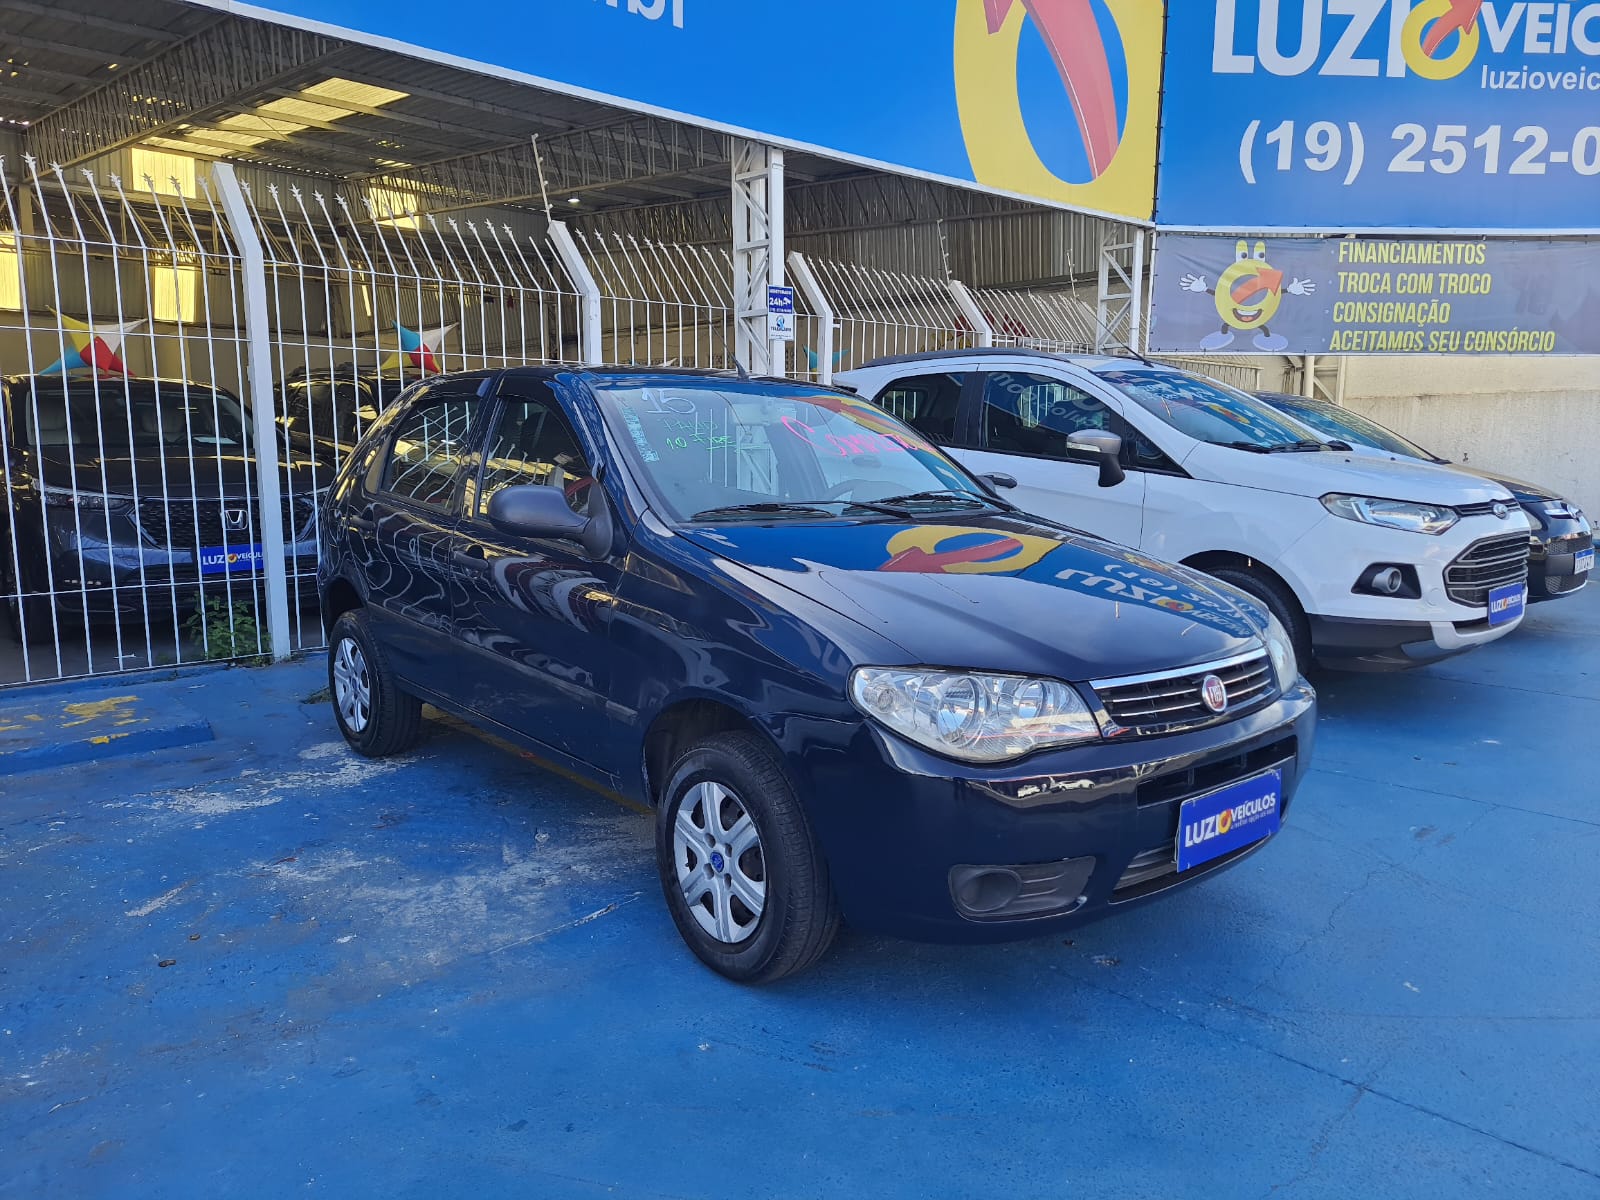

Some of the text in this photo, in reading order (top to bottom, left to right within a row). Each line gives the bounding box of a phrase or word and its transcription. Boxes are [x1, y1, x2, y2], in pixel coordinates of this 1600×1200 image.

[1481, 65, 1600, 90] luzioveic
[1239, 120, 1600, 185] (19) 2512-0
[1338, 242, 1486, 265] FINANCIAMENTOS
[1338, 271, 1491, 295] TROCA COM TROCO
[1332, 299, 1450, 327] CONSIGNAÇÃO
[1329, 327, 1555, 352] ACEITAMOS SEU CONSÓRCIO
